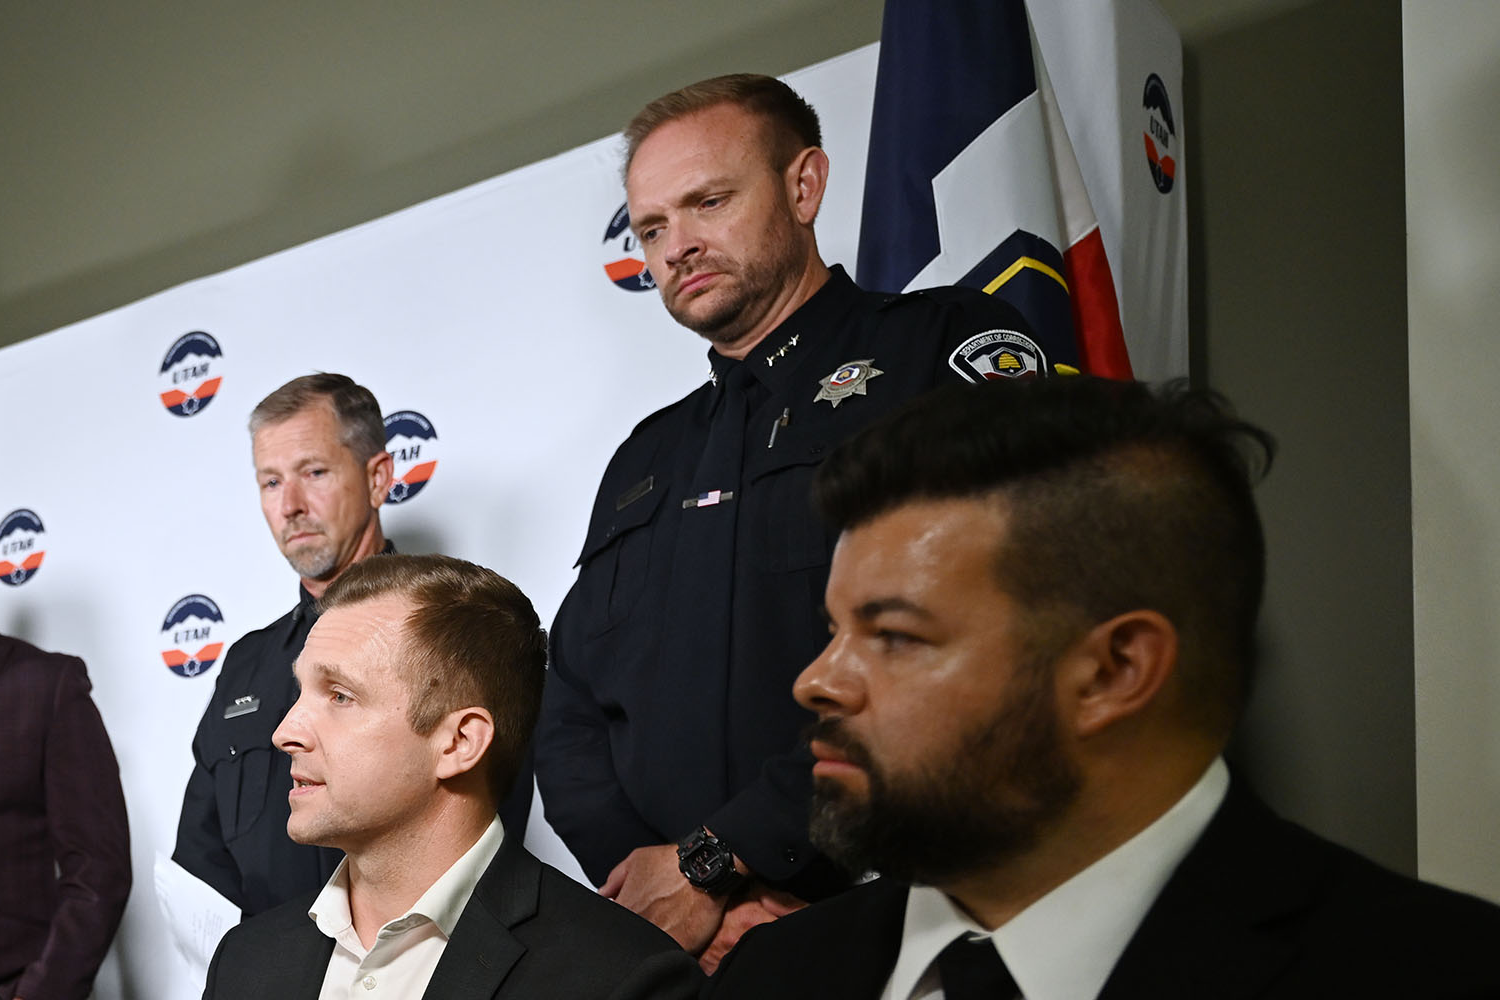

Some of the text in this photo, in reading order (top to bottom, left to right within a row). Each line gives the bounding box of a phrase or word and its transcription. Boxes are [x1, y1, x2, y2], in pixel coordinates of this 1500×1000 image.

[959, 334, 994, 357] DEPARTMENT
[172, 362, 210, 385] UTAH
[174, 626, 211, 645] UTAH
